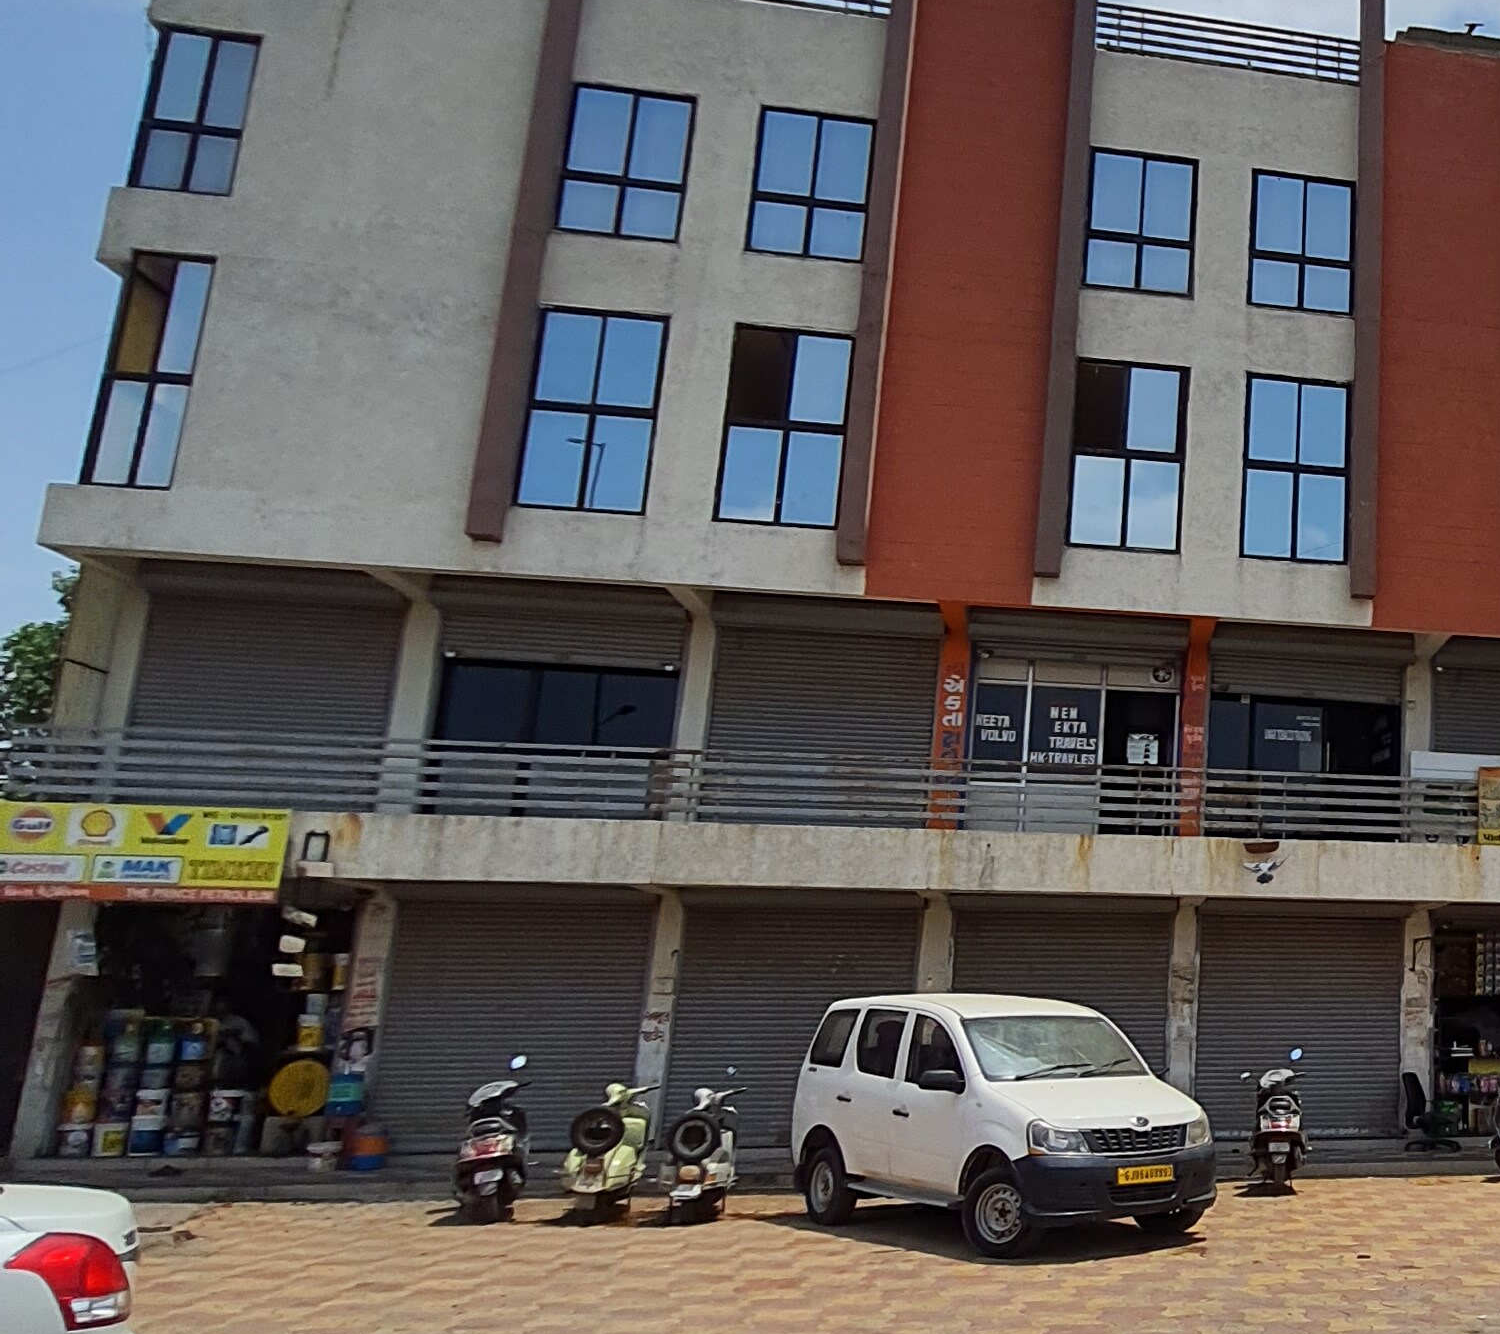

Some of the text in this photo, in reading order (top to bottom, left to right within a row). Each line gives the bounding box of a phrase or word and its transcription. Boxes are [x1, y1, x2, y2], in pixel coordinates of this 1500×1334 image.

[1054, 721, 1087, 734] EKTA
[1048, 736, 1097, 750] TRAVELS
[121, 858, 174, 872] MAK
